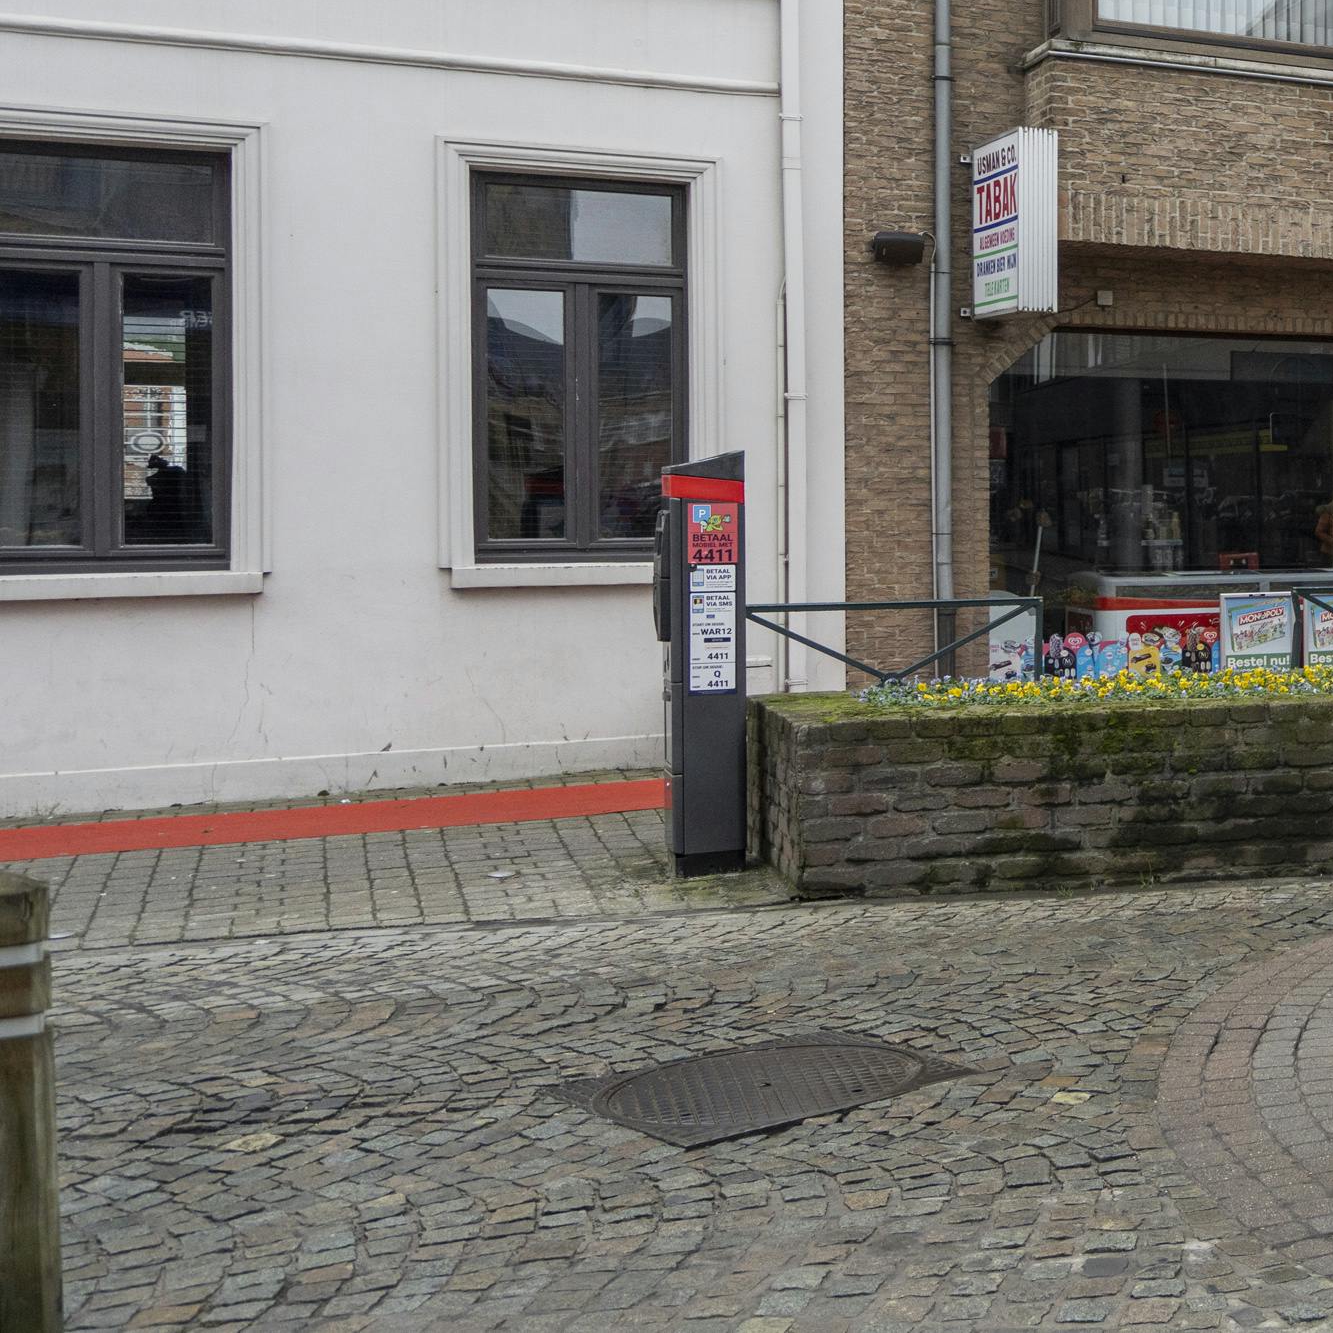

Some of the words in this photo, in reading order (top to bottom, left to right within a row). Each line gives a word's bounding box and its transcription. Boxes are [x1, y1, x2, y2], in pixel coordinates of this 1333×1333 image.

[977, 150, 1000, 176] USMAN
[1001, 148, 1006, 166] &
[1007, 144, 1017, 164] CO.
[977, 172, 1017, 225] TABAK
[692, 534, 733, 542] BETAAL
[692, 549, 732, 562] 4411
[1228, 656, 1267, 667] Bestel
[1270, 655, 1290, 665] nu!
[714, 670, 721, 678] Q
